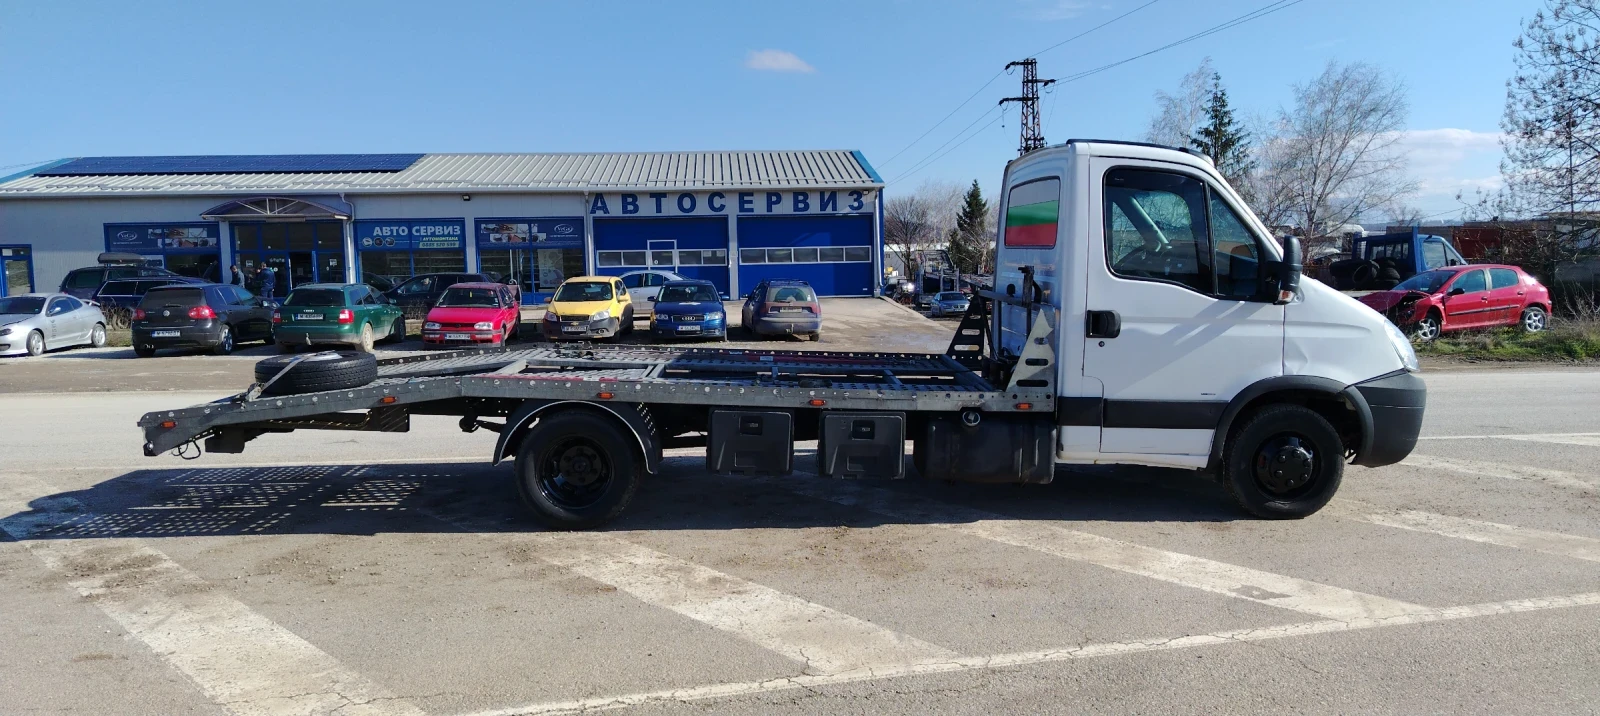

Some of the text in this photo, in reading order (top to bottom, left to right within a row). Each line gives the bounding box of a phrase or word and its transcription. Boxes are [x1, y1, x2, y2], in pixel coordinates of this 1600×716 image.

[590, 190, 864, 215] АВТОСЕРВИЗ
[373, 225, 460, 236] АВТО СЕРВИЗ
